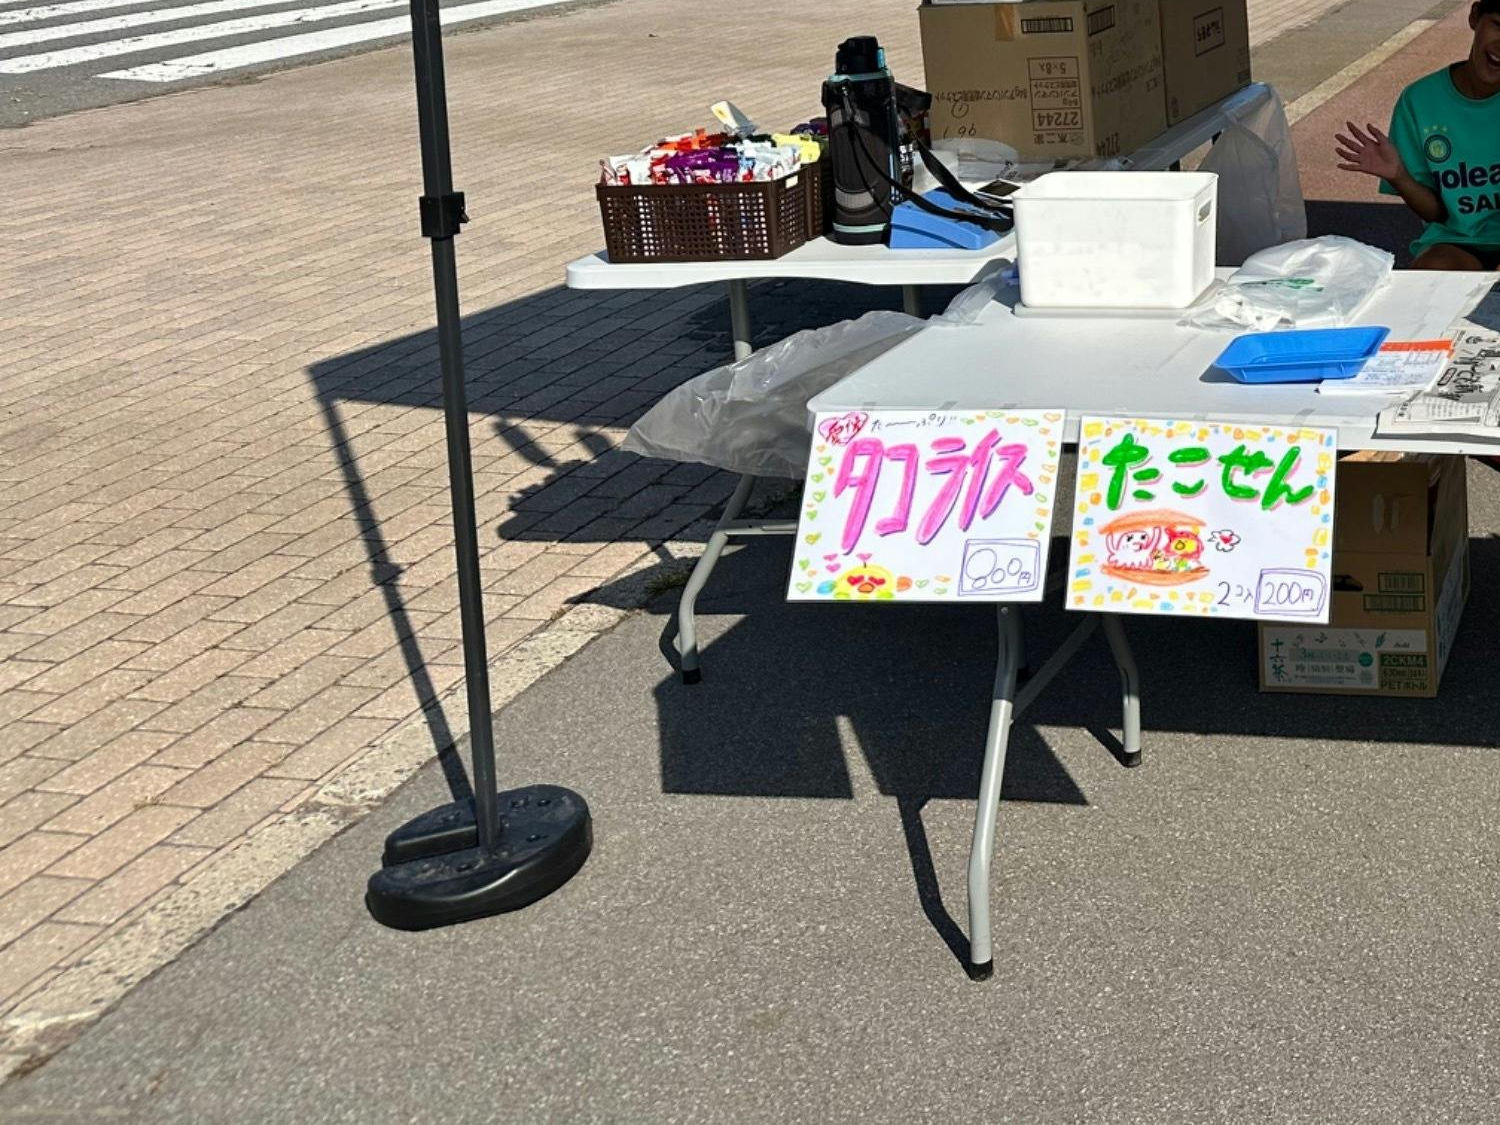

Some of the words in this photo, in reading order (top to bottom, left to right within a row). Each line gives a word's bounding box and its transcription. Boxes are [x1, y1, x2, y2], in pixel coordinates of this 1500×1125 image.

[1036, 111, 1079, 126] 27244
[832, 427, 1035, 556] タコライス
[1100, 433, 1315, 512] たこせん
[1262, 581, 1314, 605] 200円
